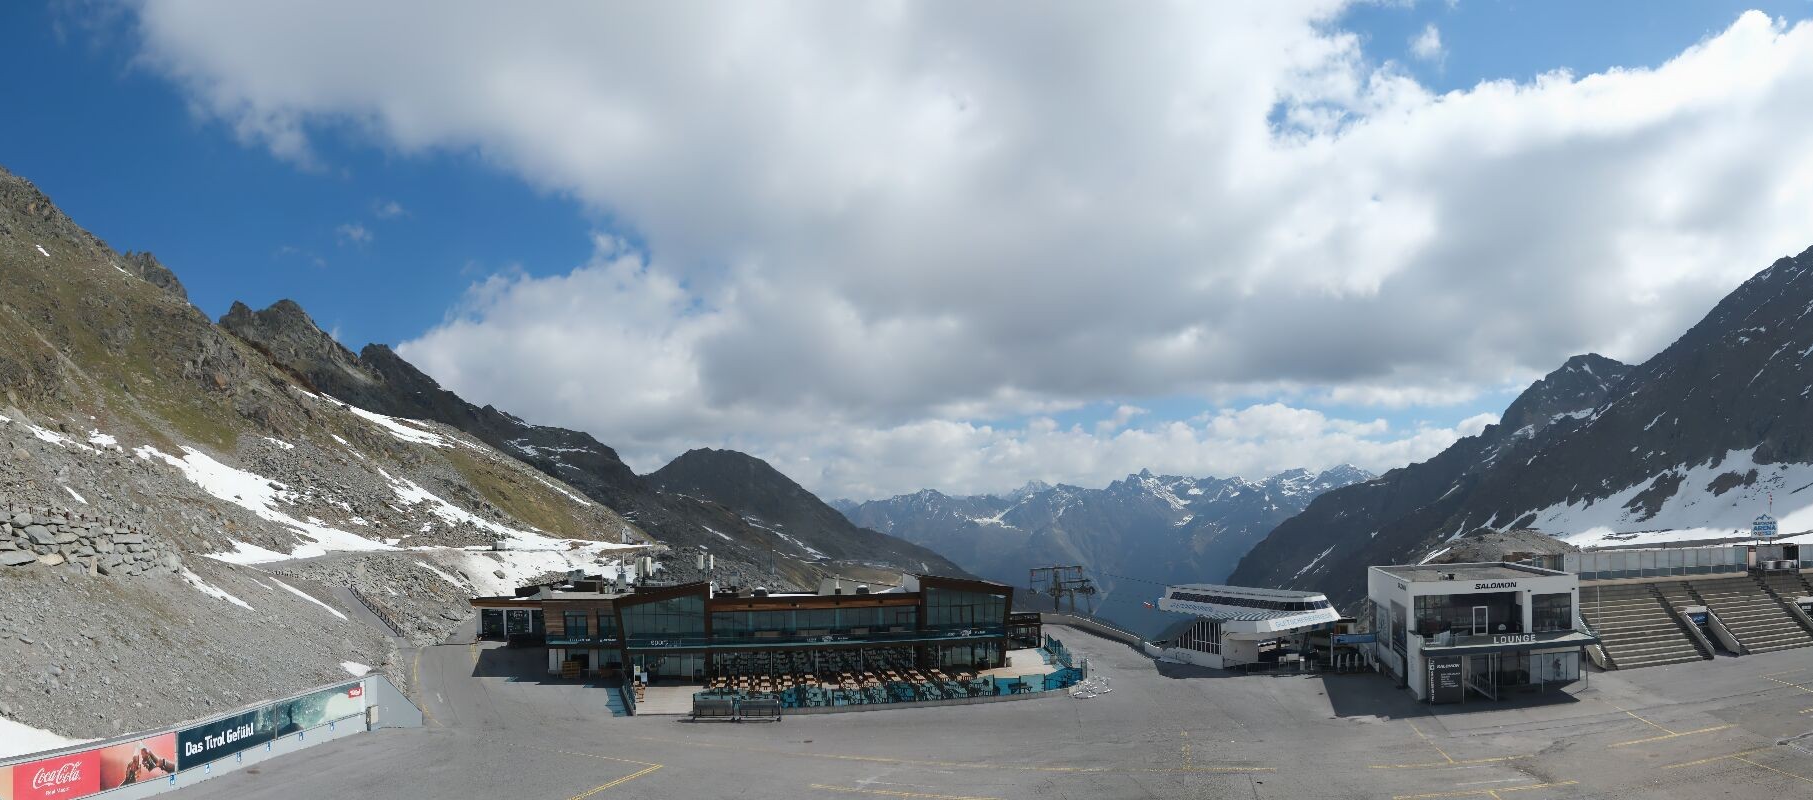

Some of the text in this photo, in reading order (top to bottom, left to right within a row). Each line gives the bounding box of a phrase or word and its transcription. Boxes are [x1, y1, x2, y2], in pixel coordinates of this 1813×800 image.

[1474, 582, 1517, 590] SALOMON
[1493, 634, 1536, 644] LOUNGE
[185, 722, 255, 757] Das Tirol Gefühl
